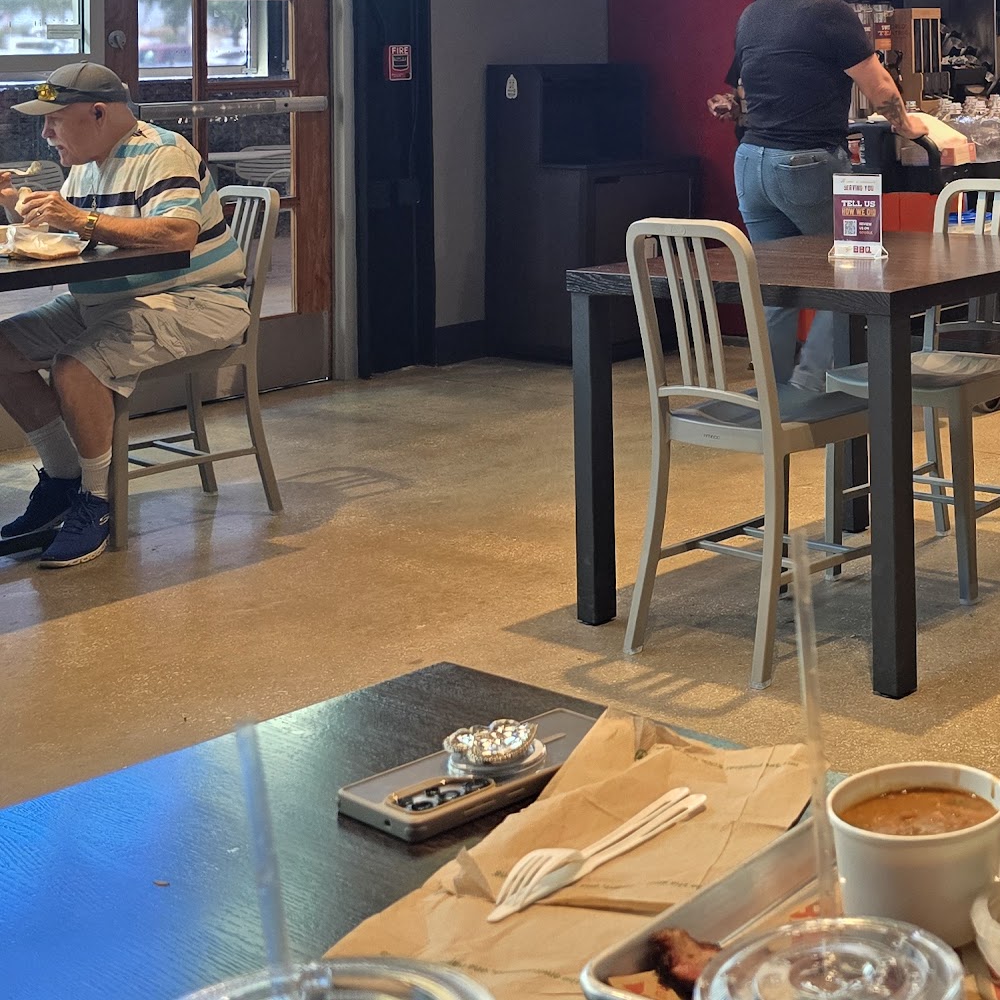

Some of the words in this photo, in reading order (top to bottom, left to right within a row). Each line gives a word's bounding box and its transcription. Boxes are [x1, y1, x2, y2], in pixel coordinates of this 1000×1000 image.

[391, 46, 409, 55] FIRE
[841, 199, 863, 207] TELL
[842, 207, 855, 217] HOW
[856, 208, 866, 217] WE
[853, 245, 872, 254] BBQ
